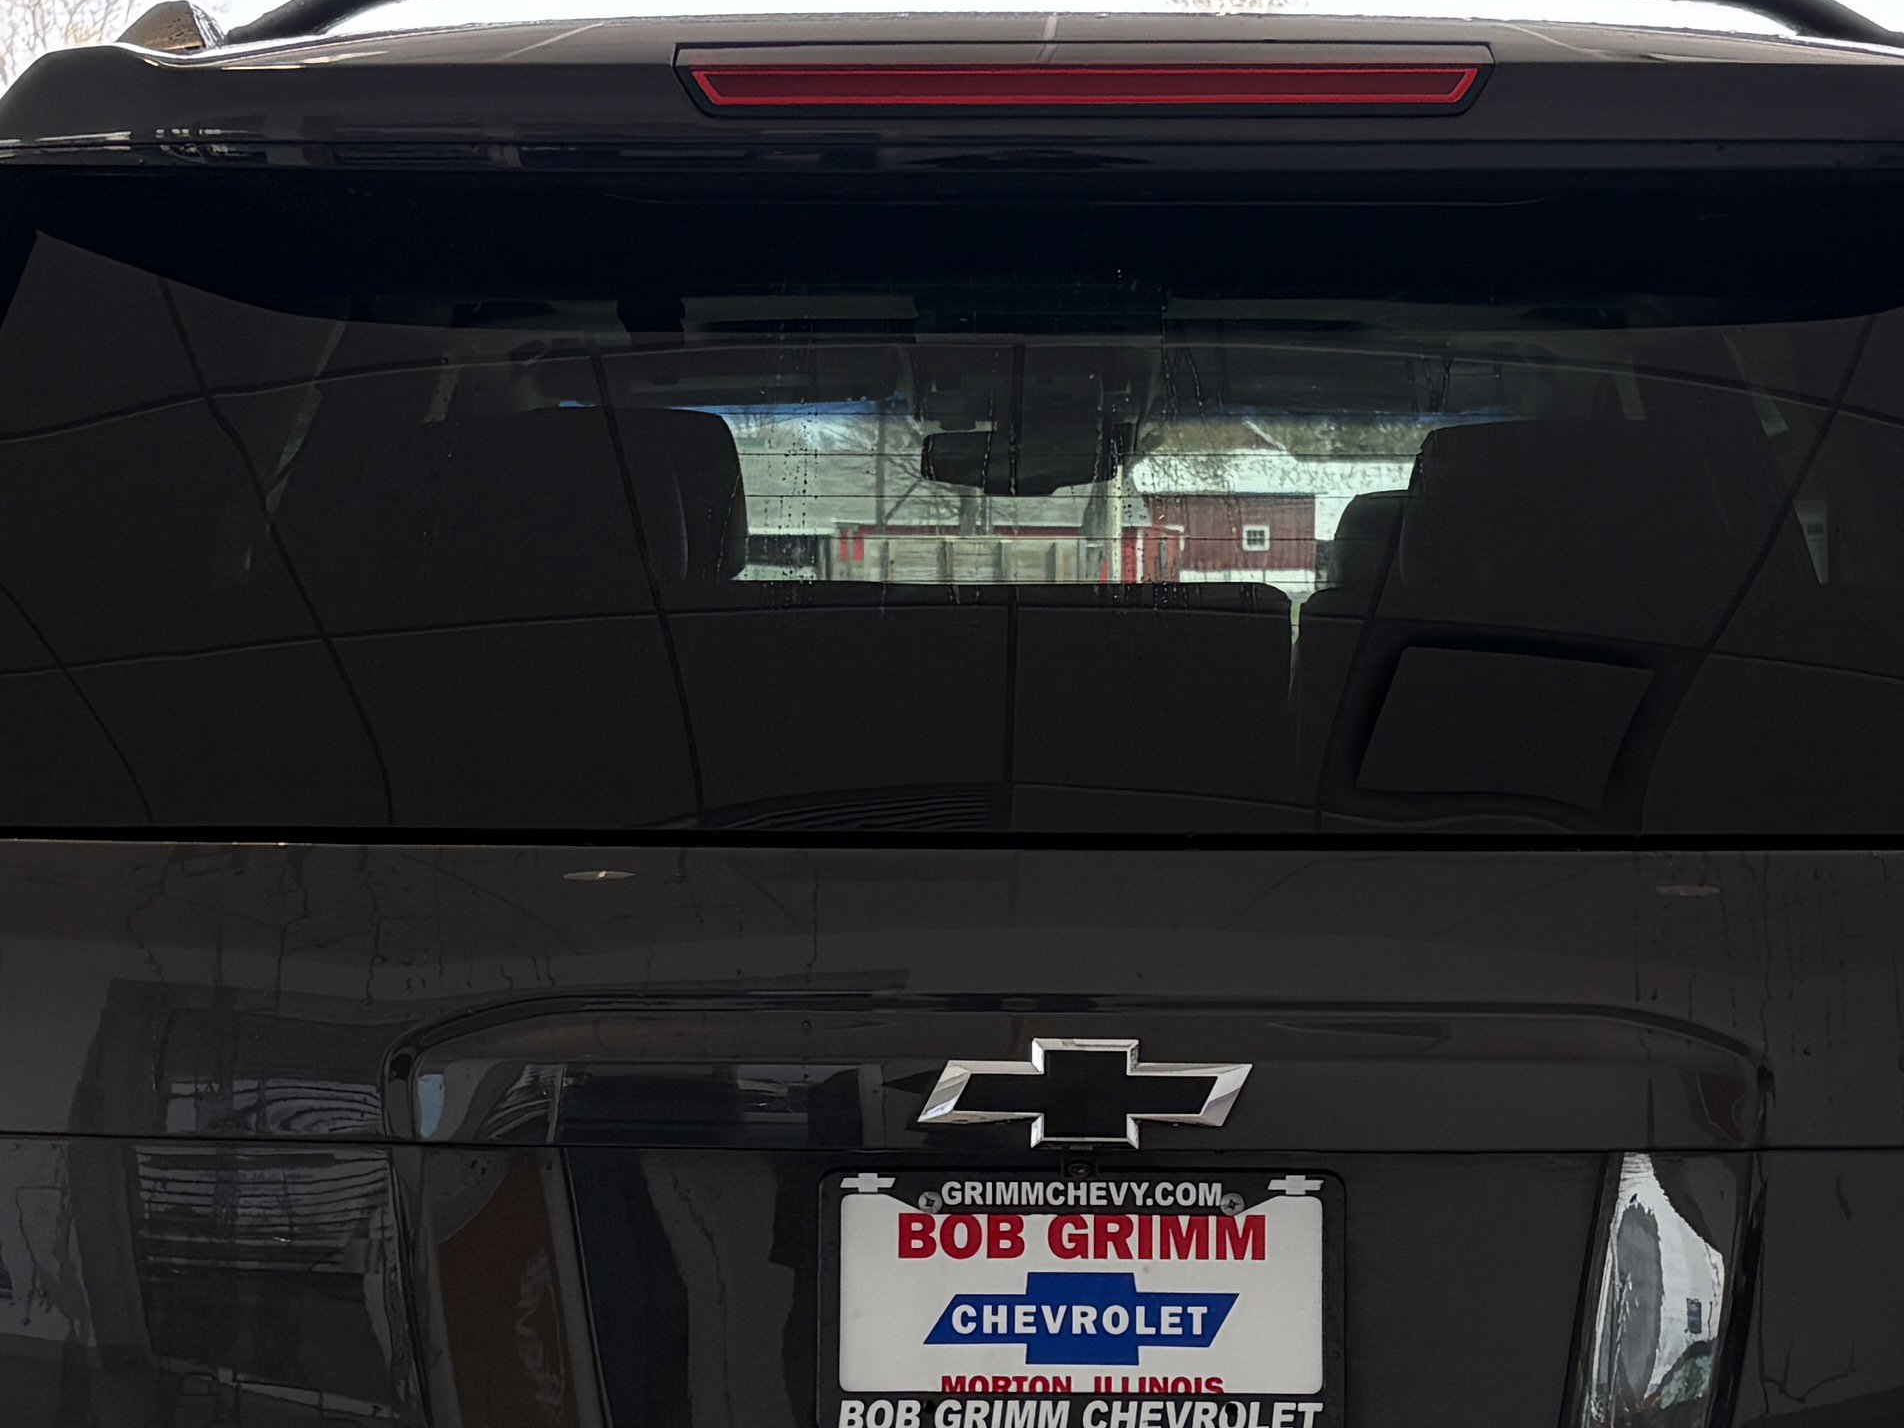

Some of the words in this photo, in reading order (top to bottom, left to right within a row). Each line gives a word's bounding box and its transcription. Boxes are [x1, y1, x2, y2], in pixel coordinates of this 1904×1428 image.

[940, 1180, 1223, 1208] GRIMMCHEVY.COM
[897, 1212, 1026, 1259] BOB
[1047, 1213, 1267, 1261] GRIMM
[950, 1303, 1209, 1336] CHEVROLET
[941, 1375, 1072, 1394] MORTON
